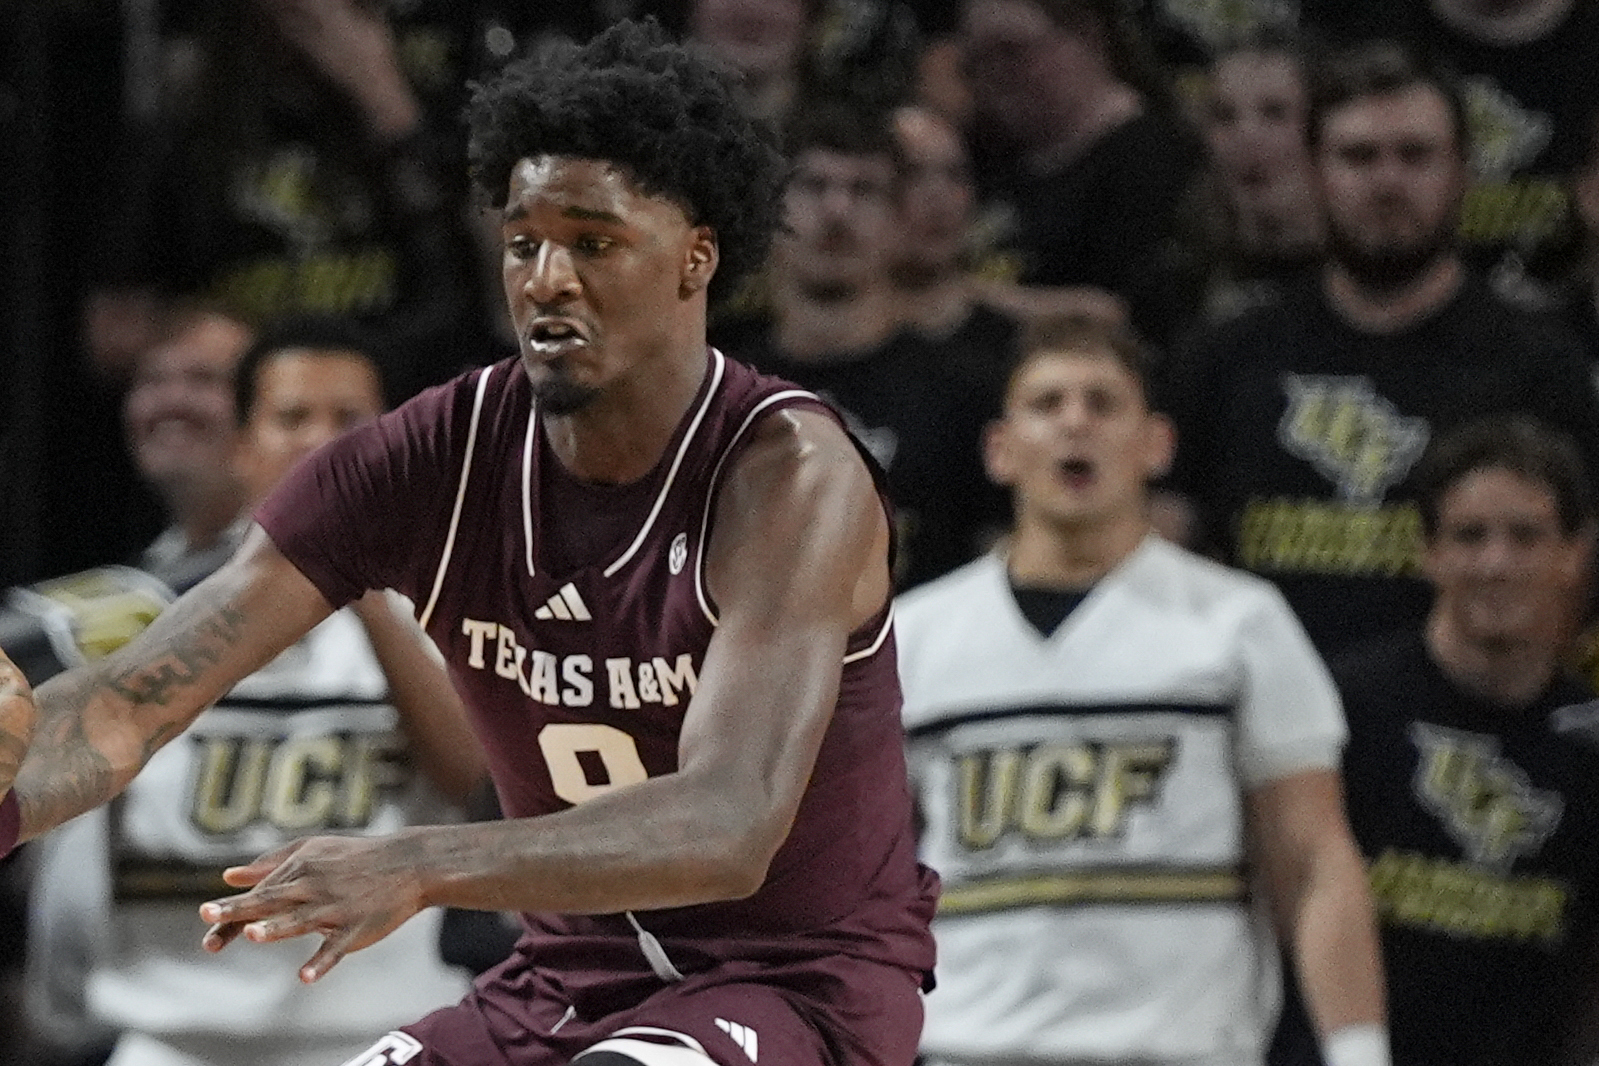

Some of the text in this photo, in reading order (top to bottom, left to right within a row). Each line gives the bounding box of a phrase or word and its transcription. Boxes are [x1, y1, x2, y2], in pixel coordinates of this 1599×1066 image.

[462, 617, 698, 709] TEXAS A&M
[193, 735, 408, 836] UCF
[953, 738, 1178, 850] UCF
